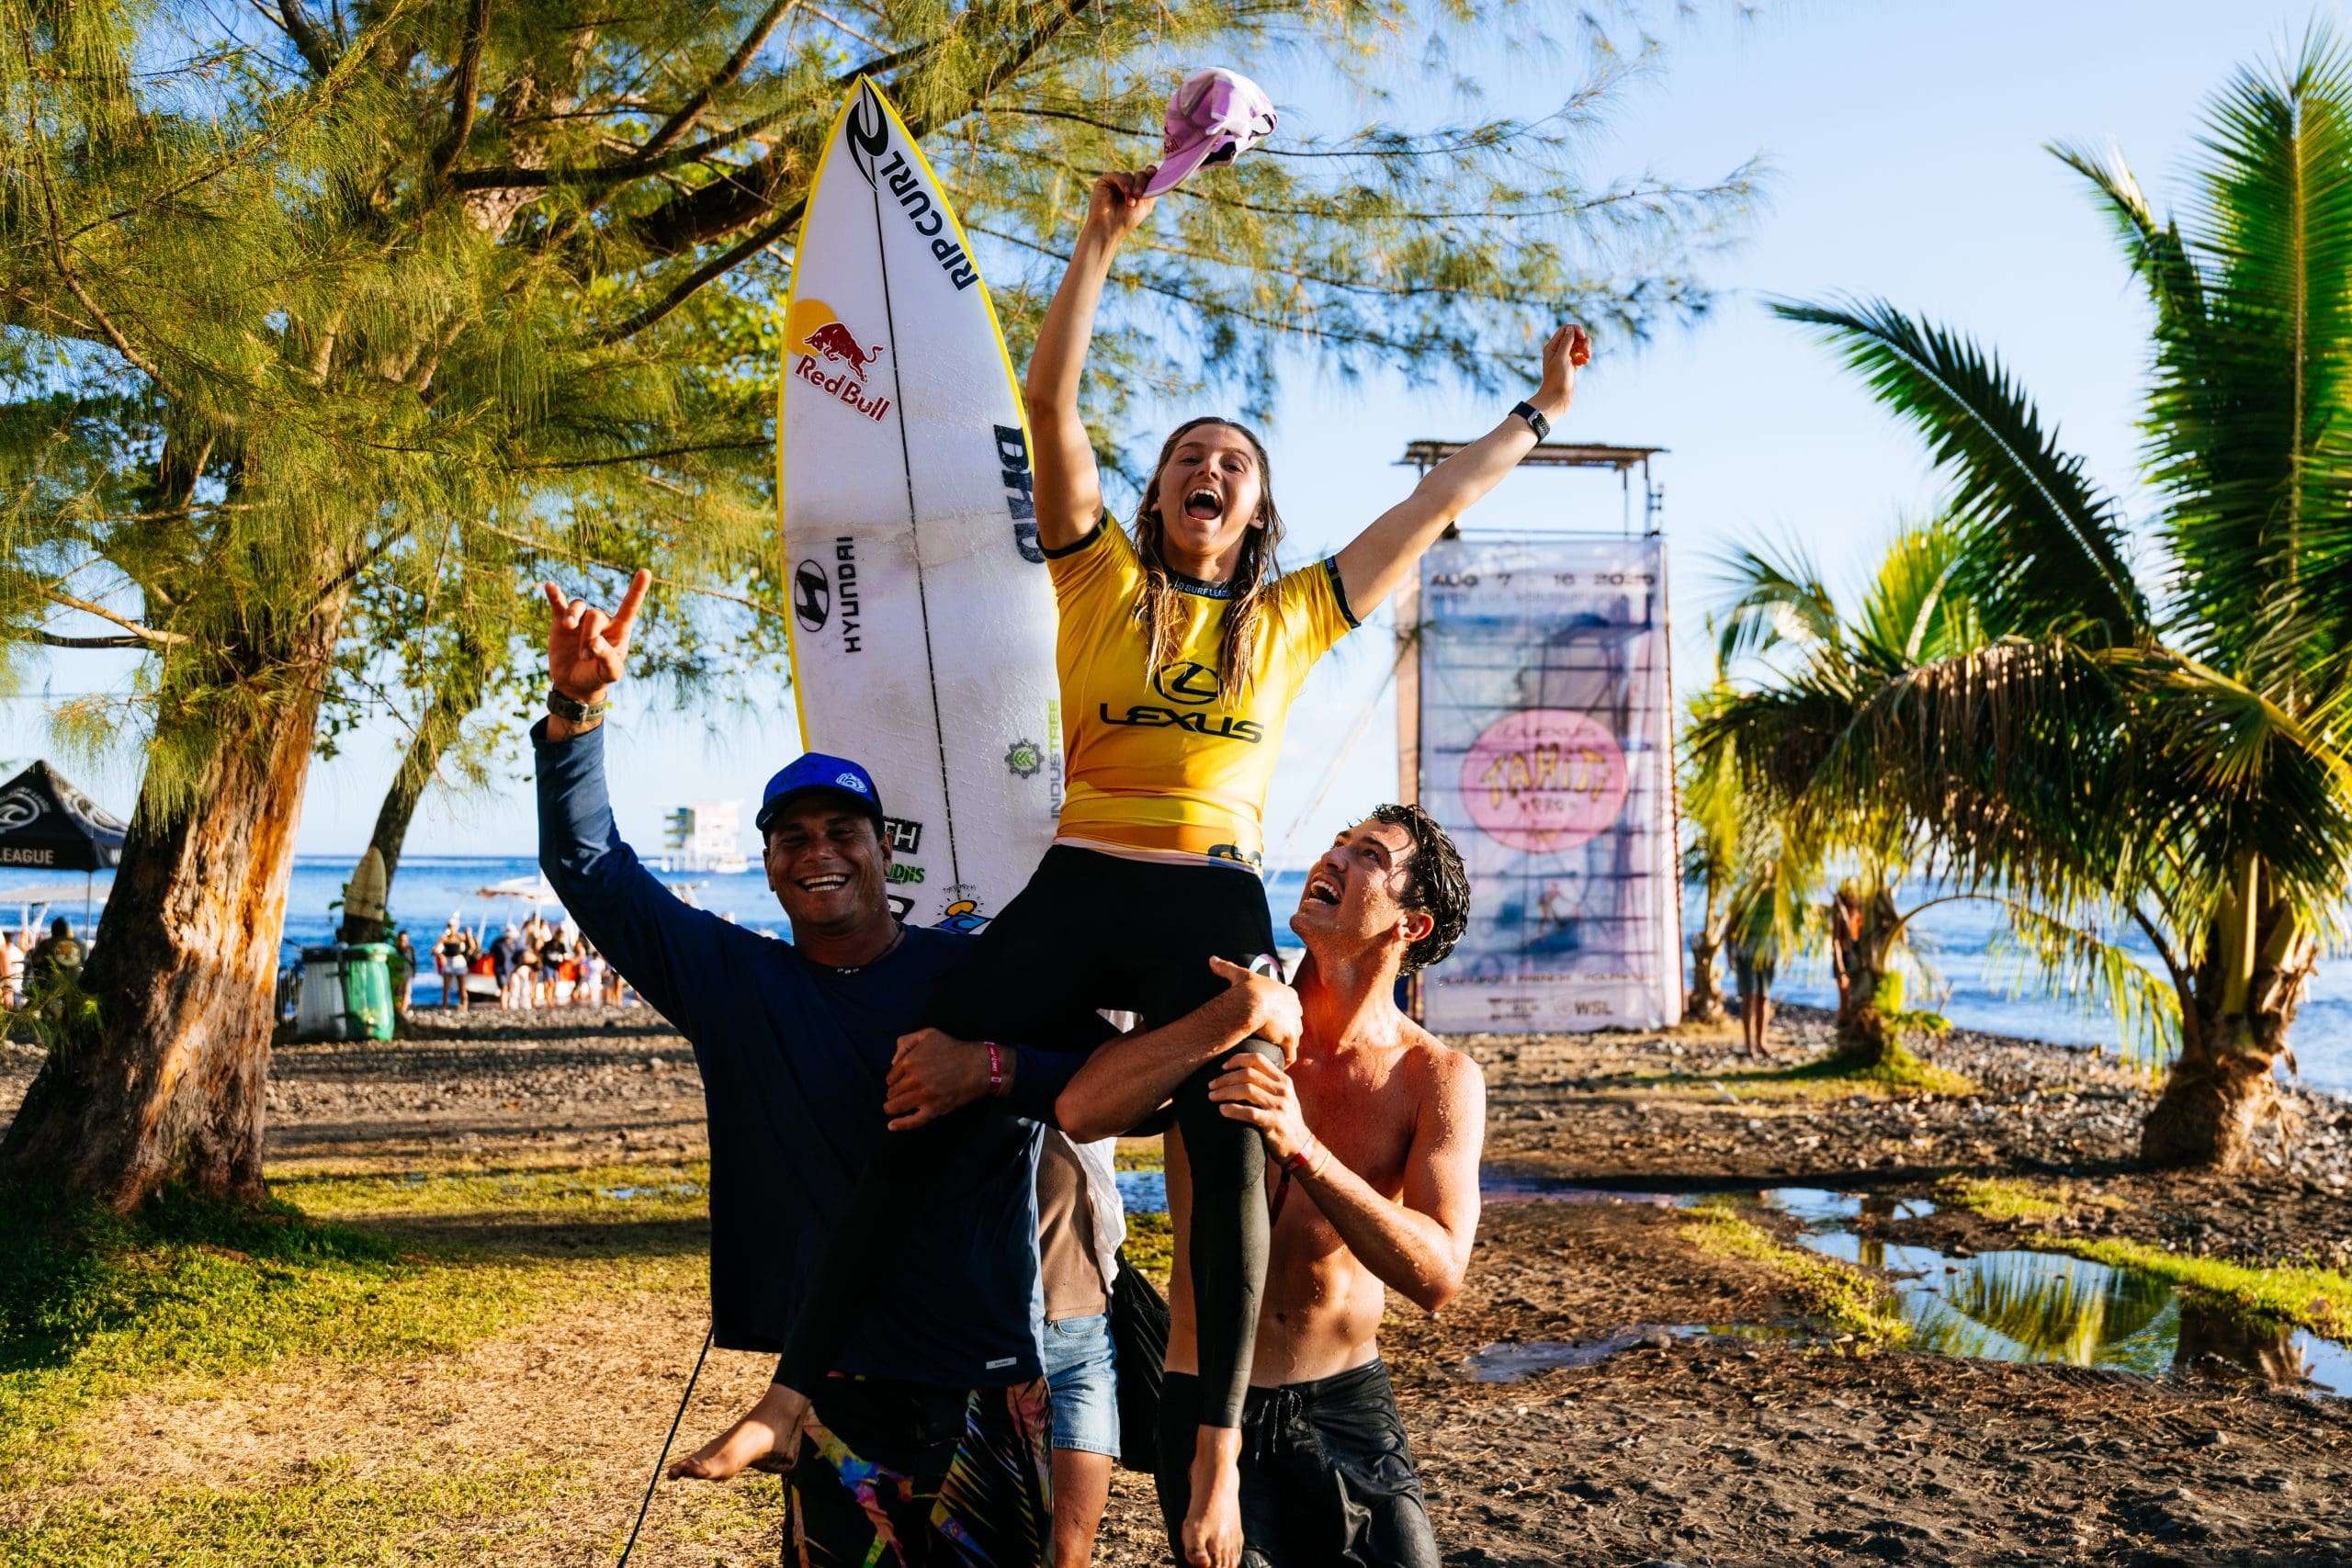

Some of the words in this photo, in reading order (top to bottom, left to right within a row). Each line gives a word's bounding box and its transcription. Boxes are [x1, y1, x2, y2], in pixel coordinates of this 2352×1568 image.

[880, 150, 943, 236] CURL
[931, 238, 979, 291] RIP
[795, 354, 846, 396] Red
[840, 380, 891, 422] Bull
[836, 536, 862, 653] HYUNDAI
[1185, 584, 1208, 595] SURF
[1209, 588, 1231, 598] LEAG
[1430, 574, 1478, 587] AUG
[1100, 703, 1264, 743] LEXUS
[1047, 698, 1062, 818] INDUSTREE
